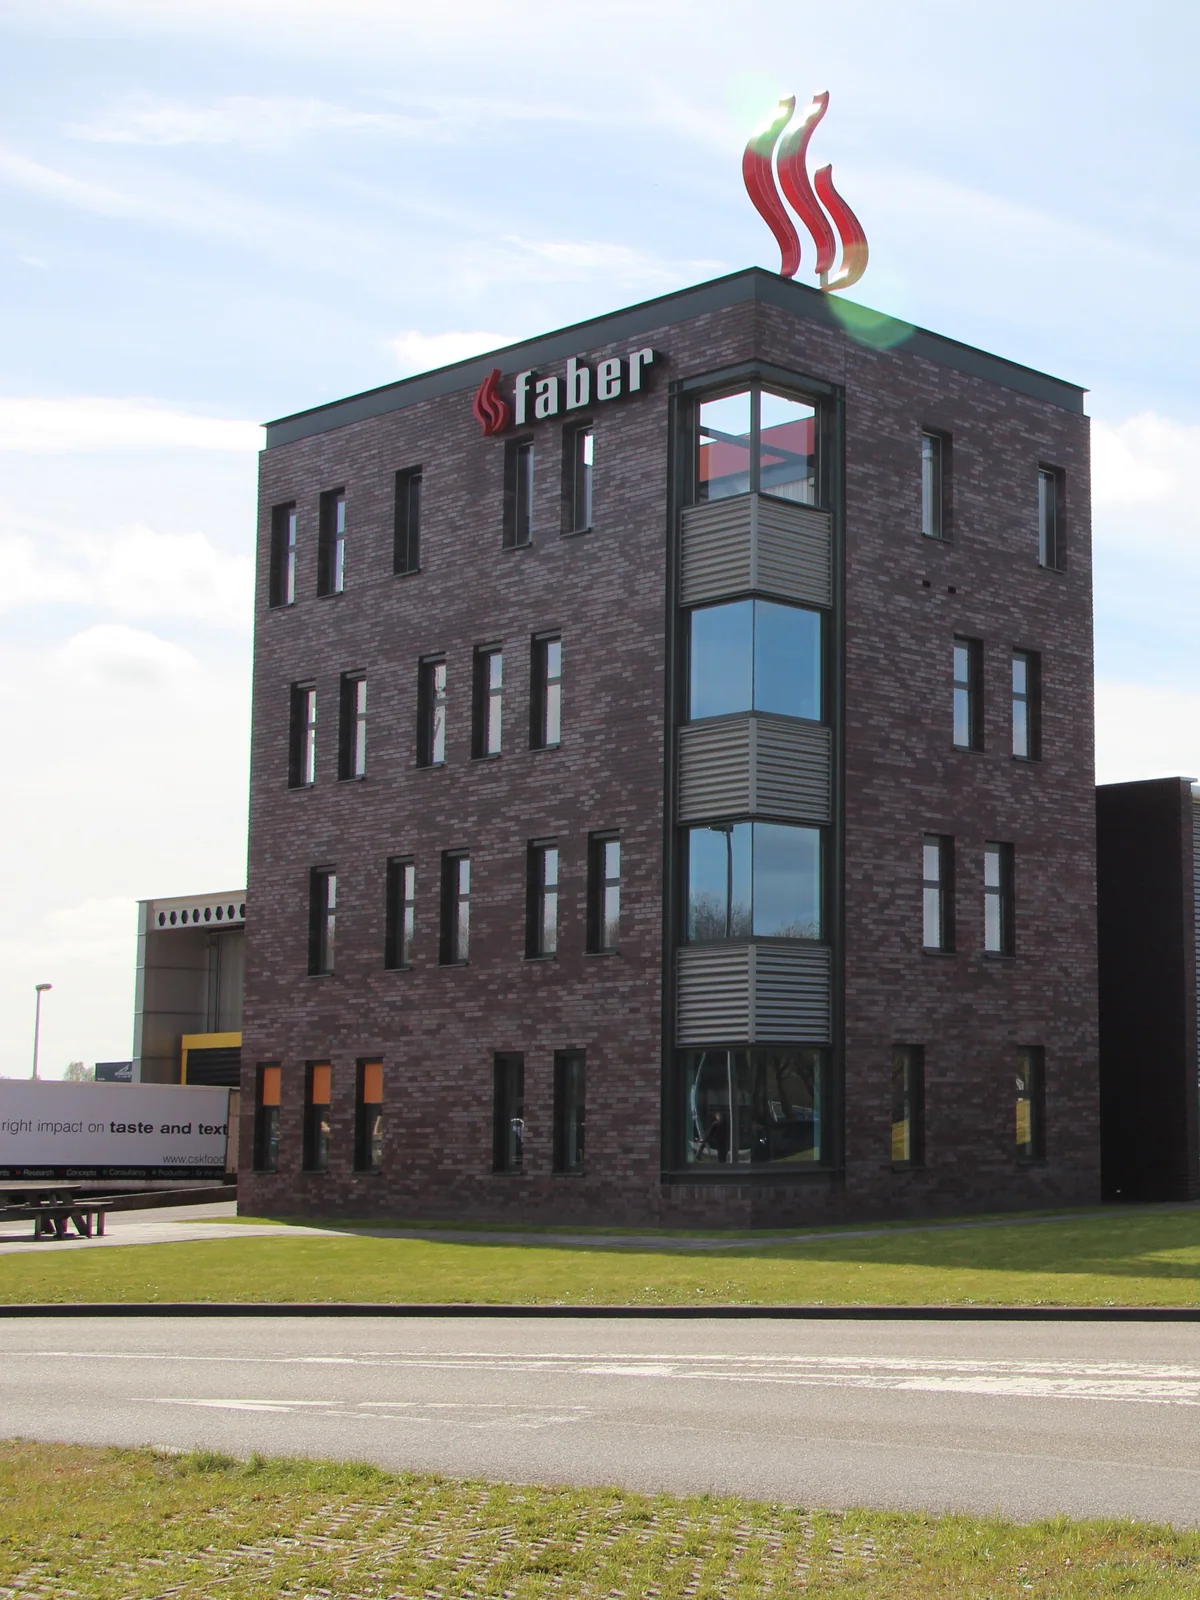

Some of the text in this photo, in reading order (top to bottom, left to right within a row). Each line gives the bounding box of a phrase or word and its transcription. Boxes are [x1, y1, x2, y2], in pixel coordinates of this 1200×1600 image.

[512, 347, 654, 426] faber
[1, 1119, 228, 1135] right impact on taste and text
[23, 1169, 54, 1177] Research
[66, 1169, 97, 1178] Concepts
